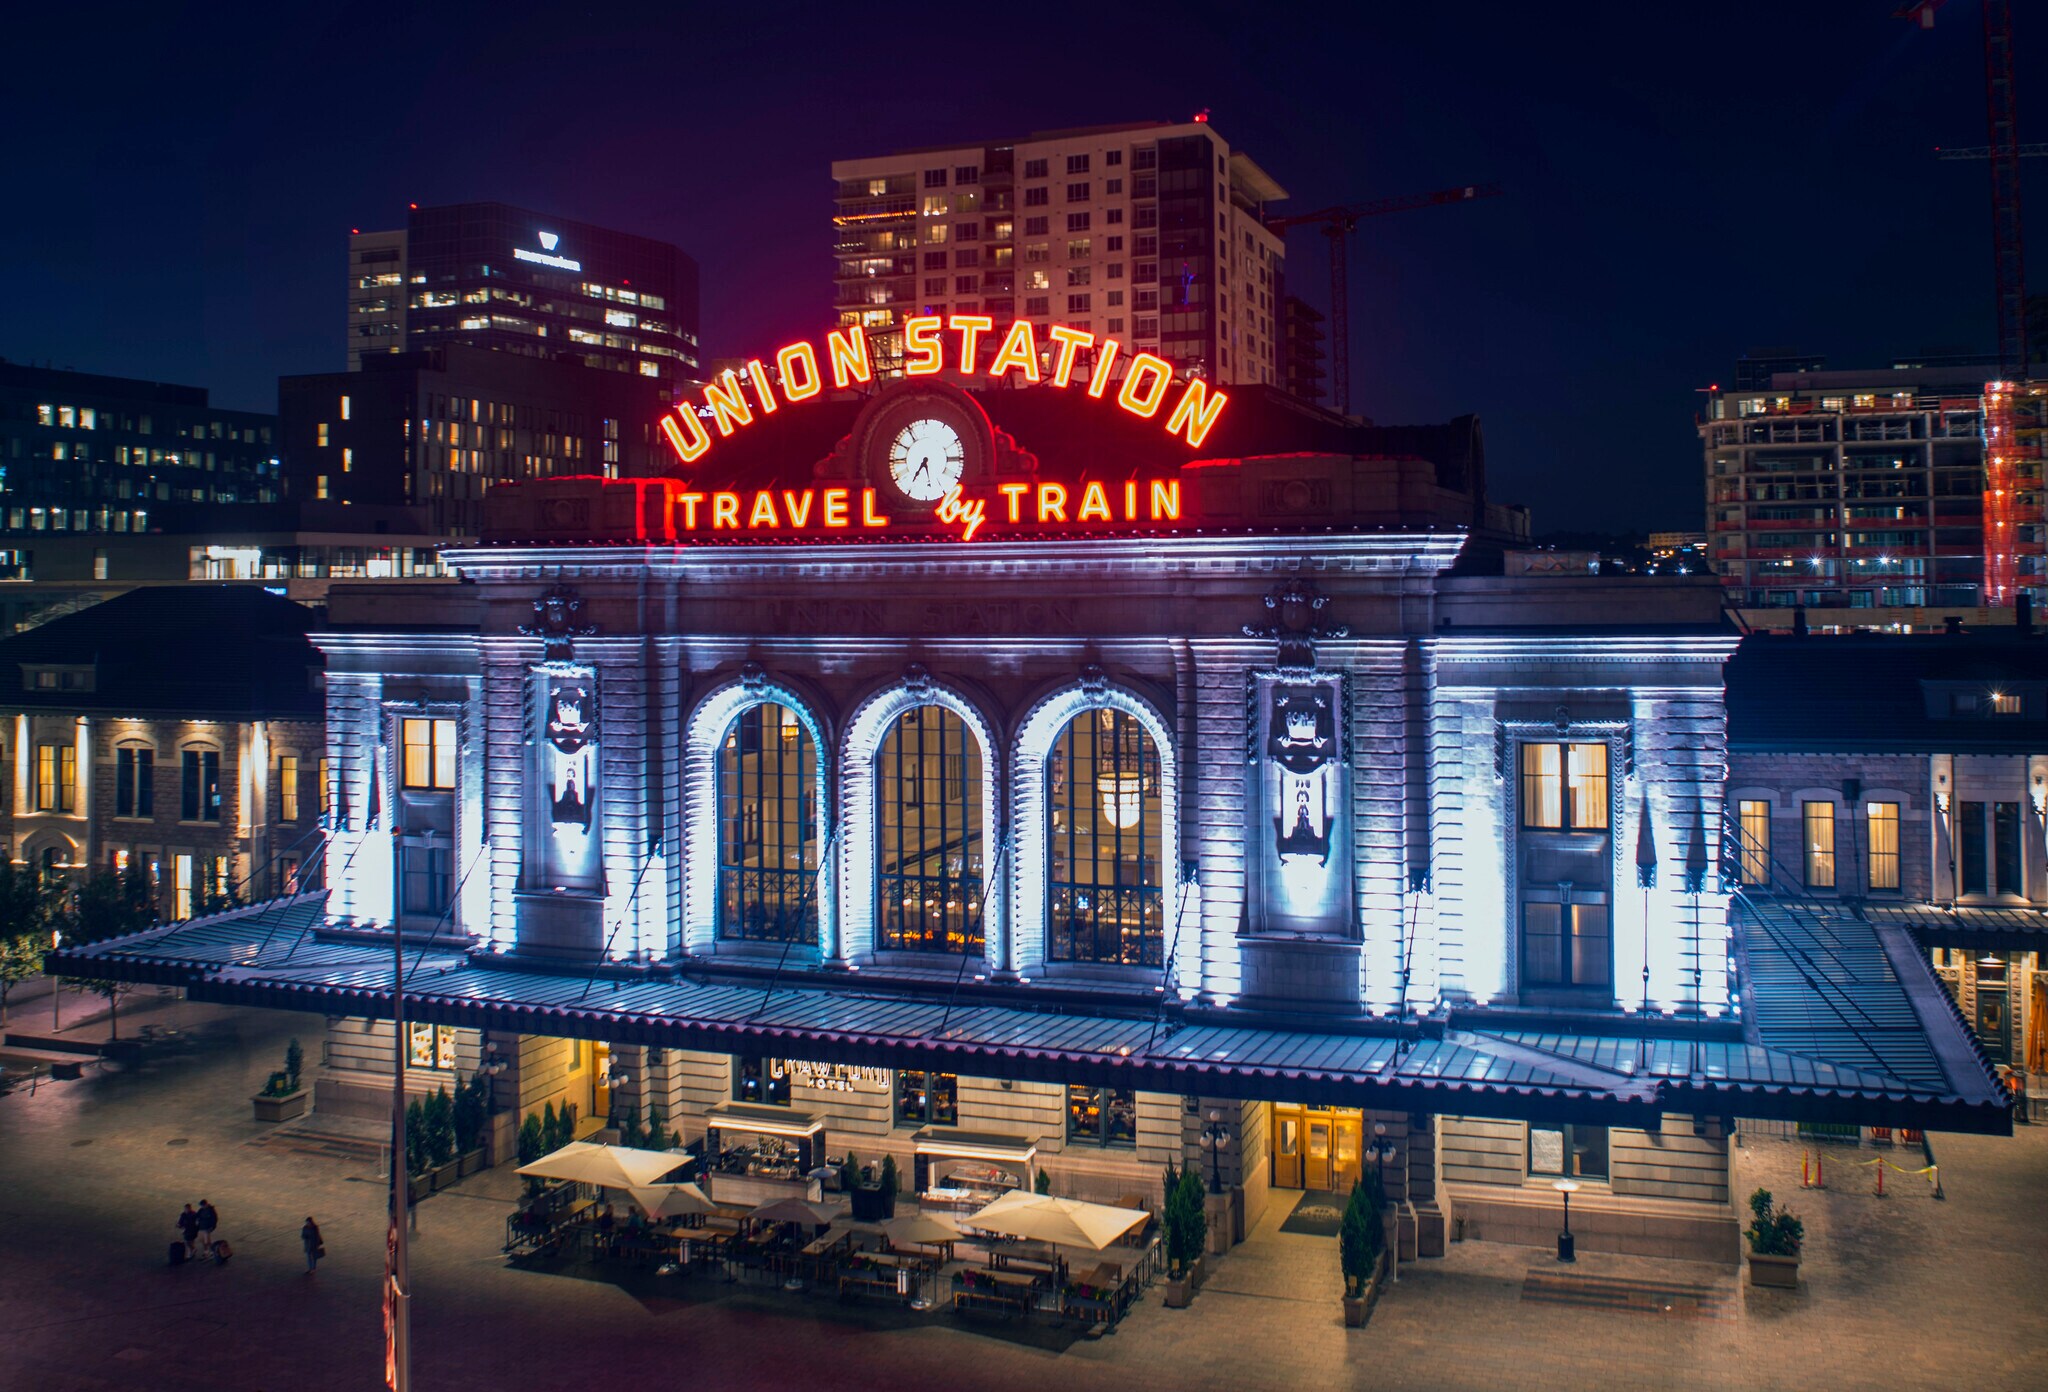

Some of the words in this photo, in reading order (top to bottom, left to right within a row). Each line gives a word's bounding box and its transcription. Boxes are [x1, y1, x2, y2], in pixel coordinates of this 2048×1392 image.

[660, 324, 872, 463] UNION
[904, 314, 1229, 449] STATION
[678, 488, 890, 529] TRAVEL
[936, 484, 985, 541] by
[1001, 479, 1182, 523] TRAIN
[806, 1078, 855, 1092] HOTEL
